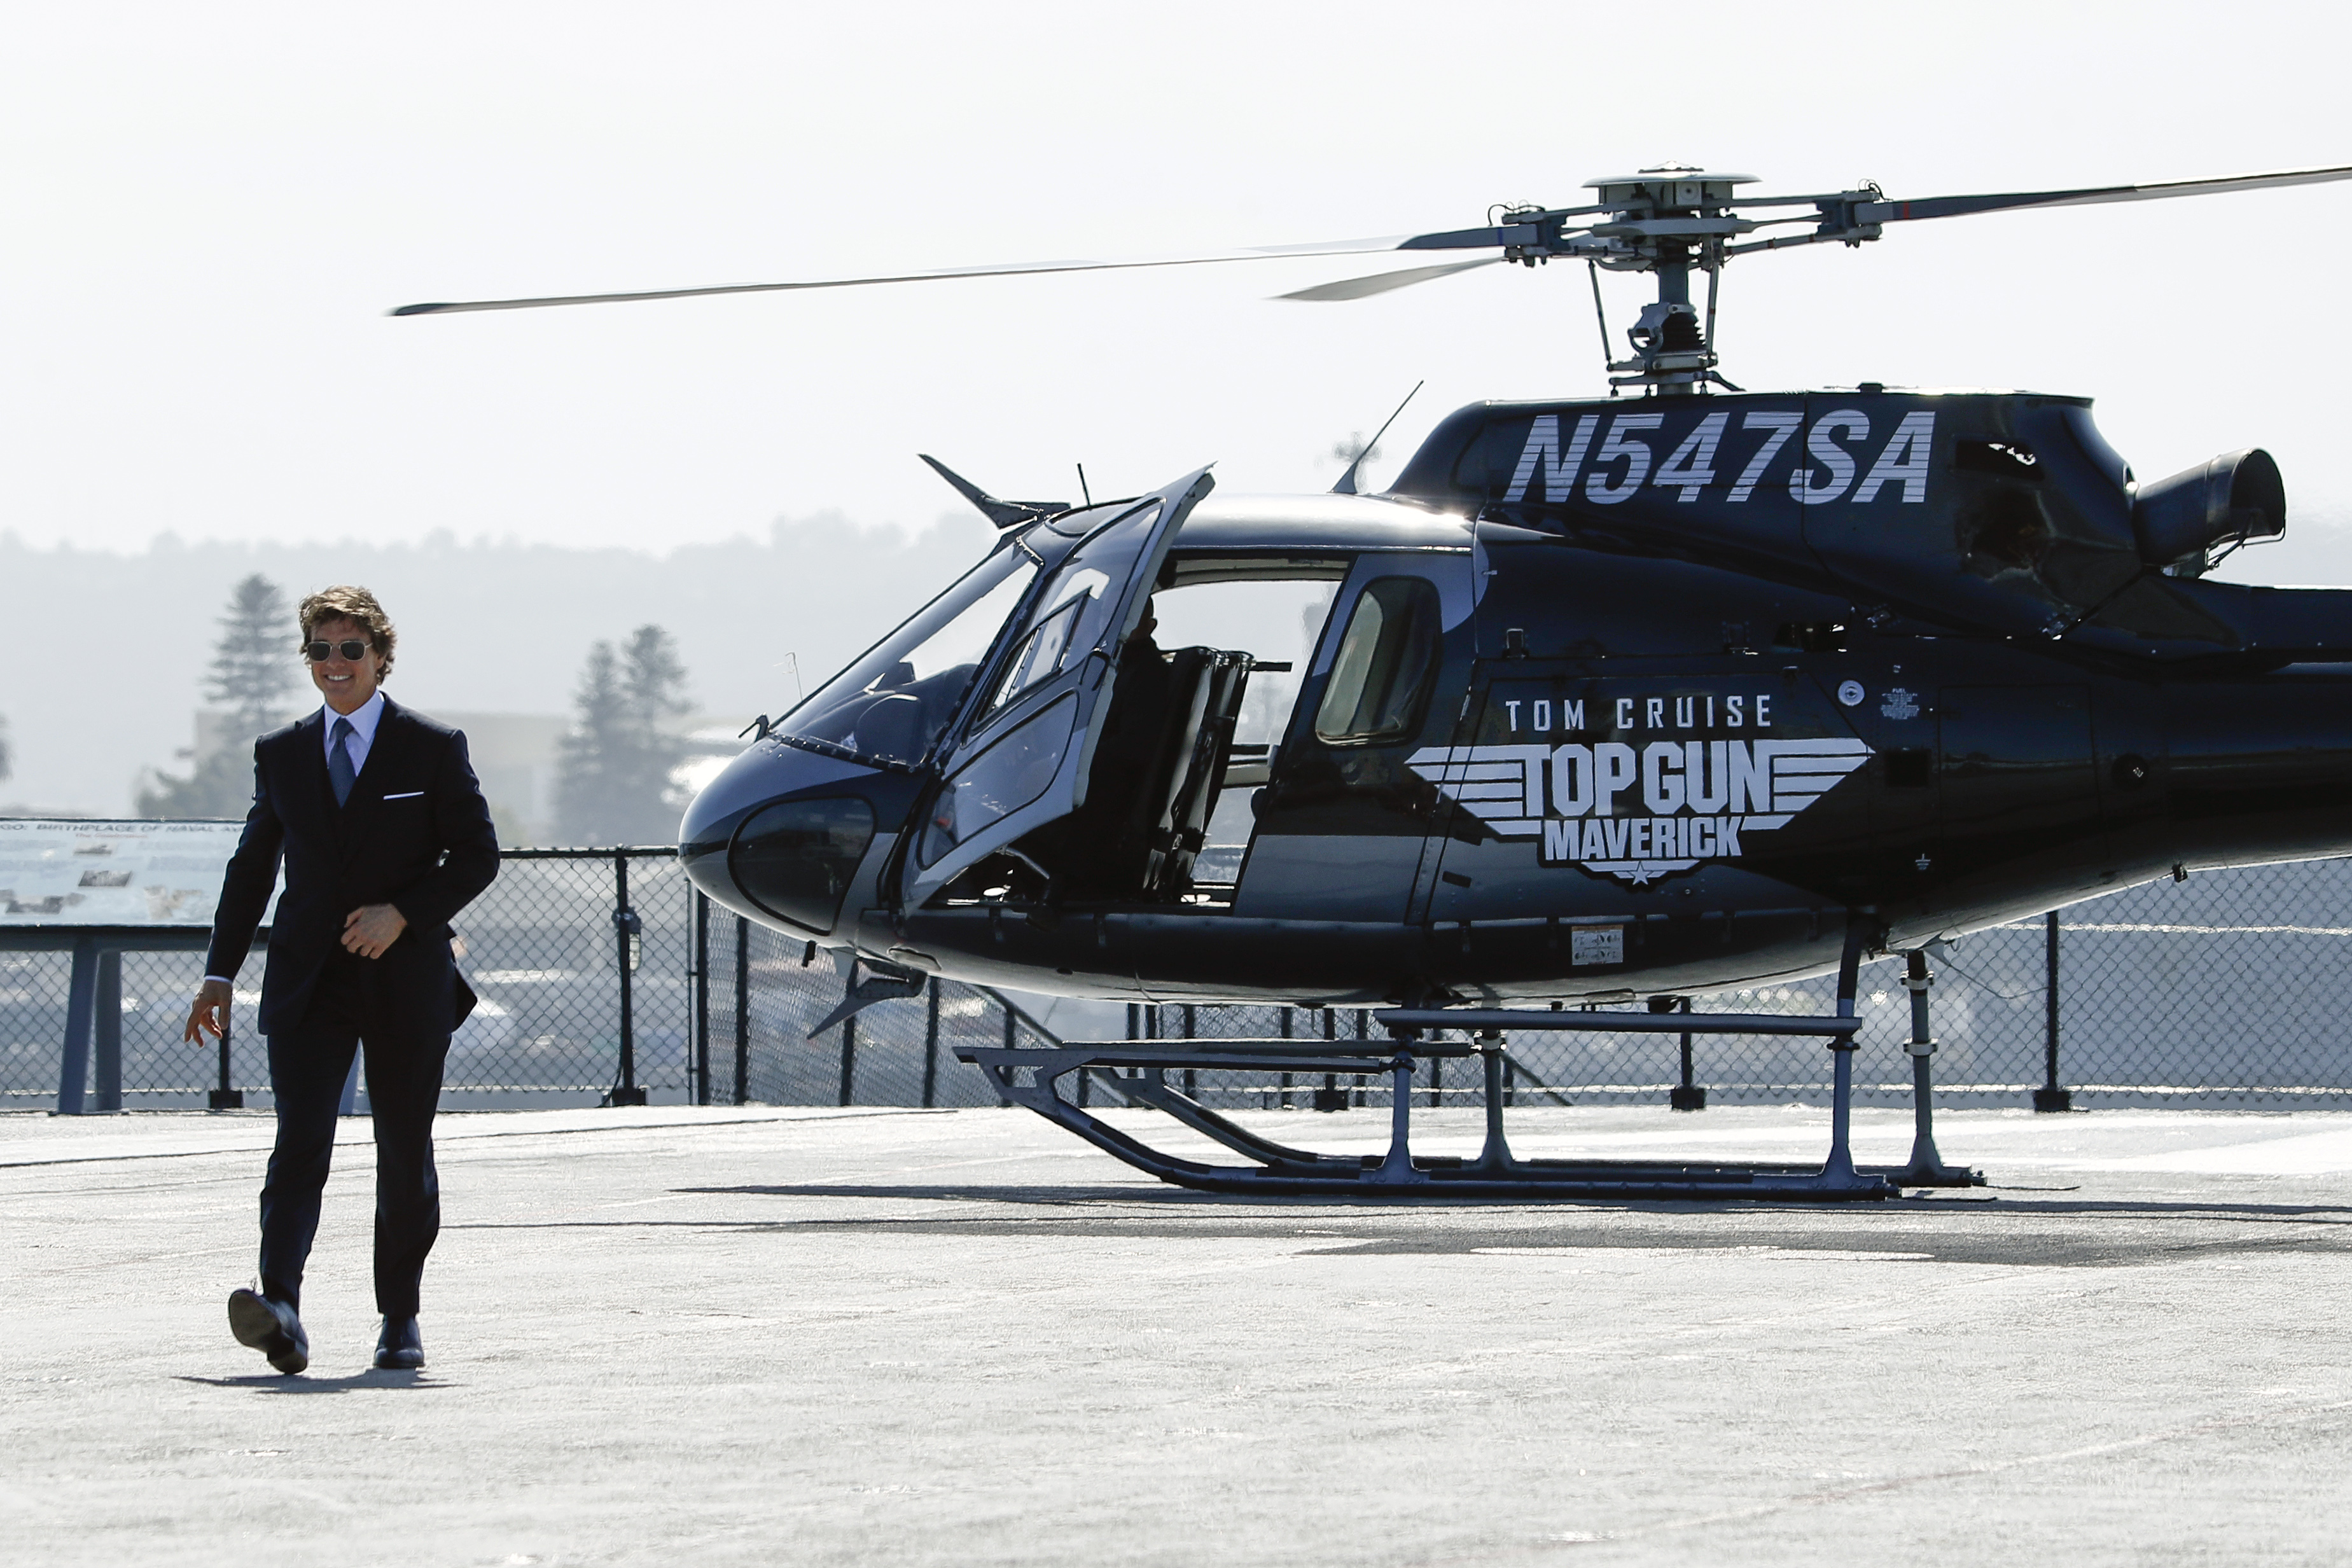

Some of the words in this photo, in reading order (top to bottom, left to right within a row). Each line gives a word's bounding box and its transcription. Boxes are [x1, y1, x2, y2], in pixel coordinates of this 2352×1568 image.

[1502, 409, 1936, 504] N547SA
[1505, 700, 1585, 732] TOM
[1617, 695, 1771, 729] CRUISE
[1522, 743, 1636, 817] TOP
[1643, 740, 1774, 814] GUN
[36, 824, 136, 832] BIRTHPLACE
[141, 824, 160, 833] OF
[1545, 816, 1742, 860] MAVERICK
